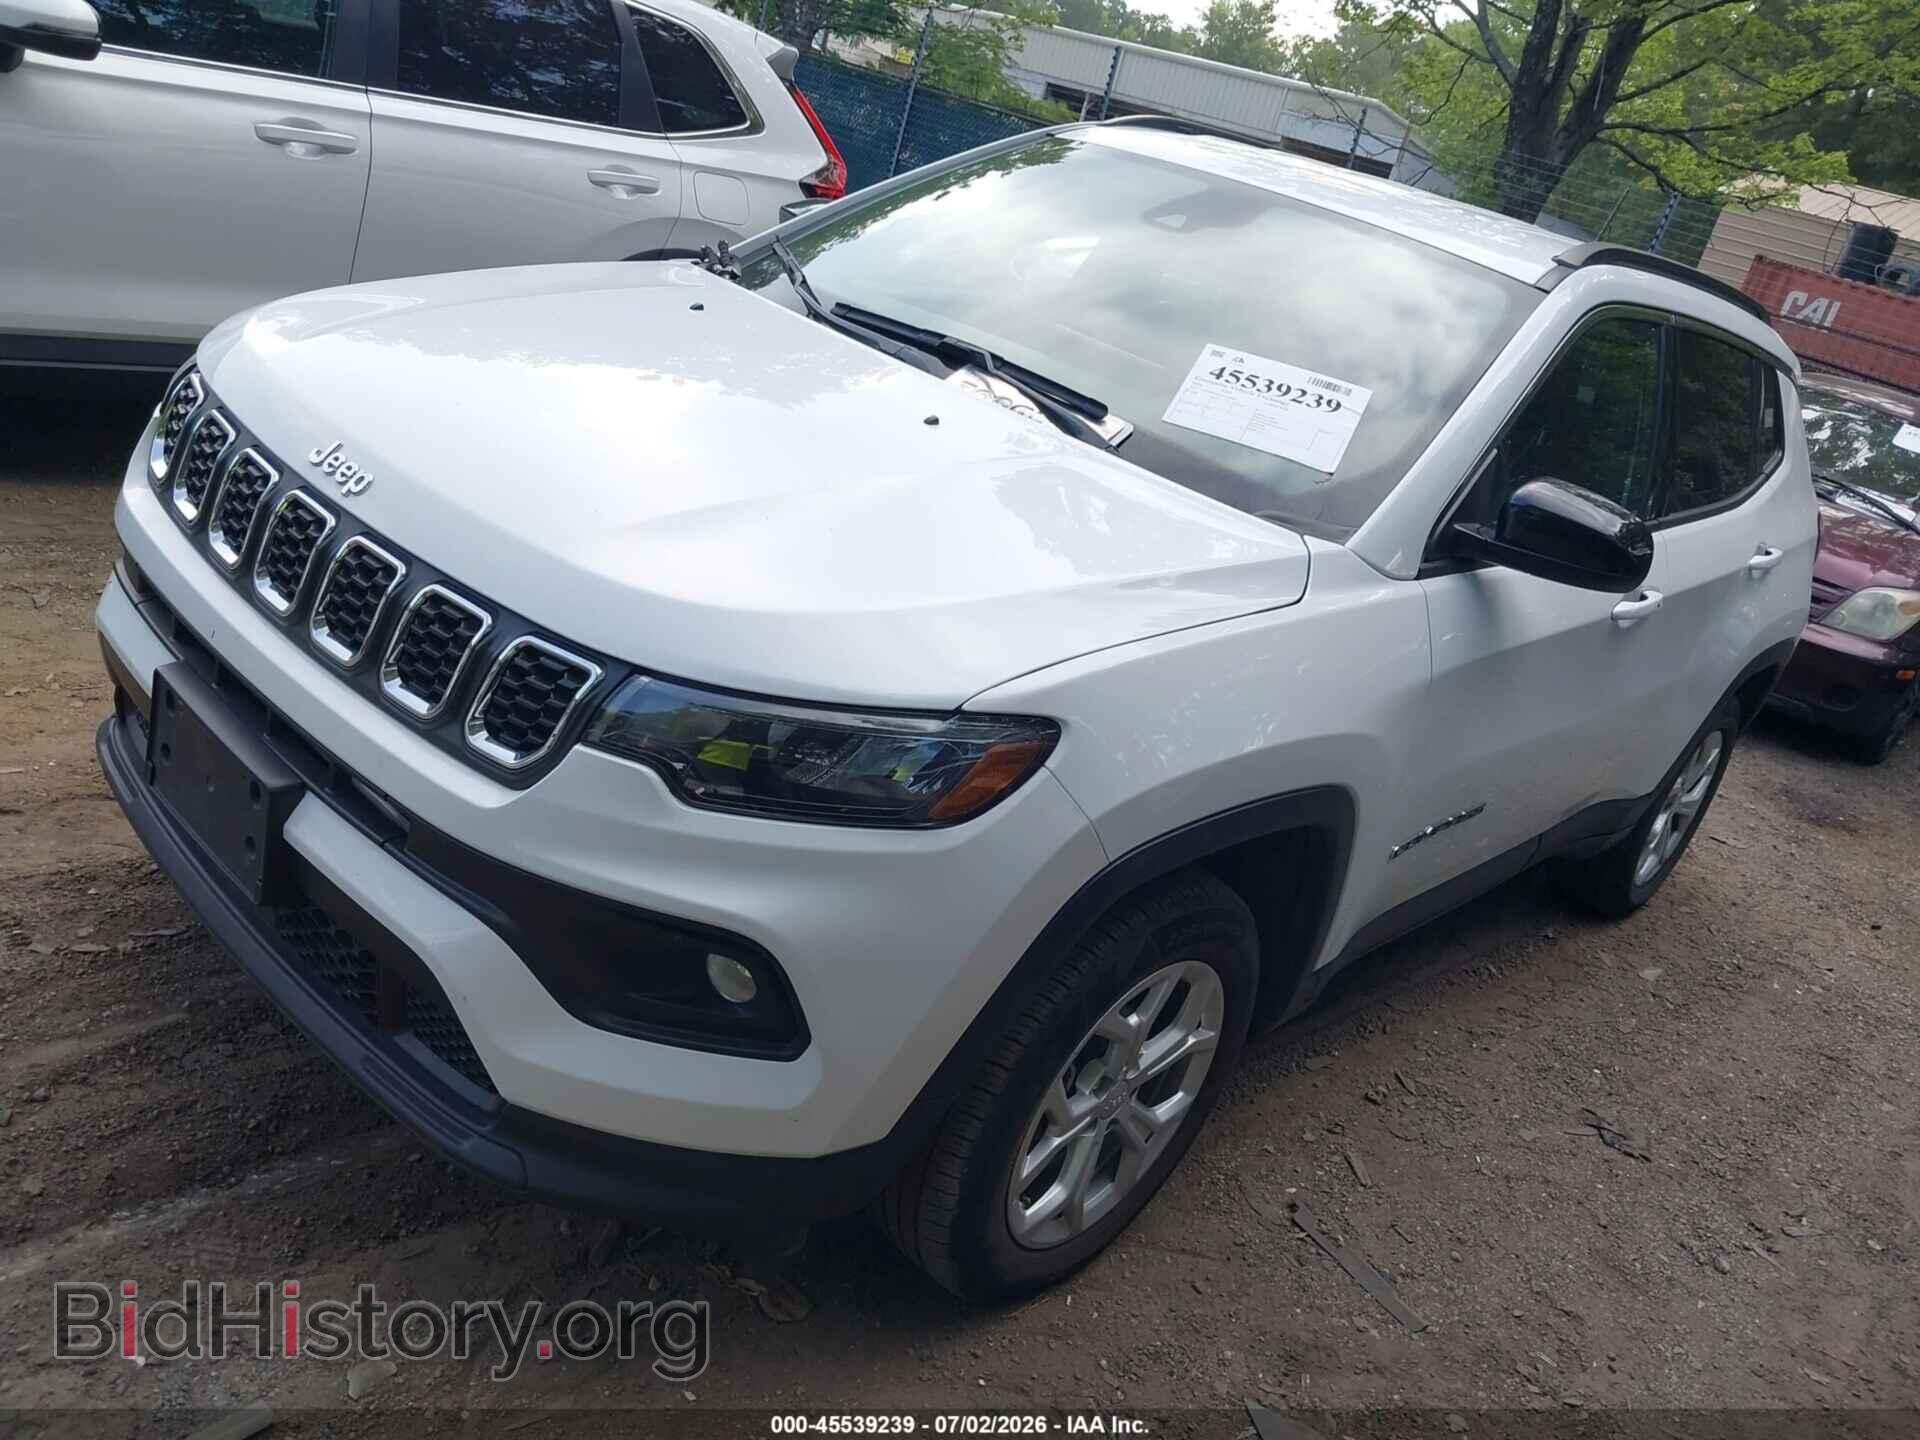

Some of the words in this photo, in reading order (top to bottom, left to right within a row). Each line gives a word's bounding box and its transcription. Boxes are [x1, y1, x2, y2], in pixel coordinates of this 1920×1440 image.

[1780, 290, 1841, 328] CAI
[1209, 366, 1342, 413] 45539239
[309, 441, 373, 496] Jeep
